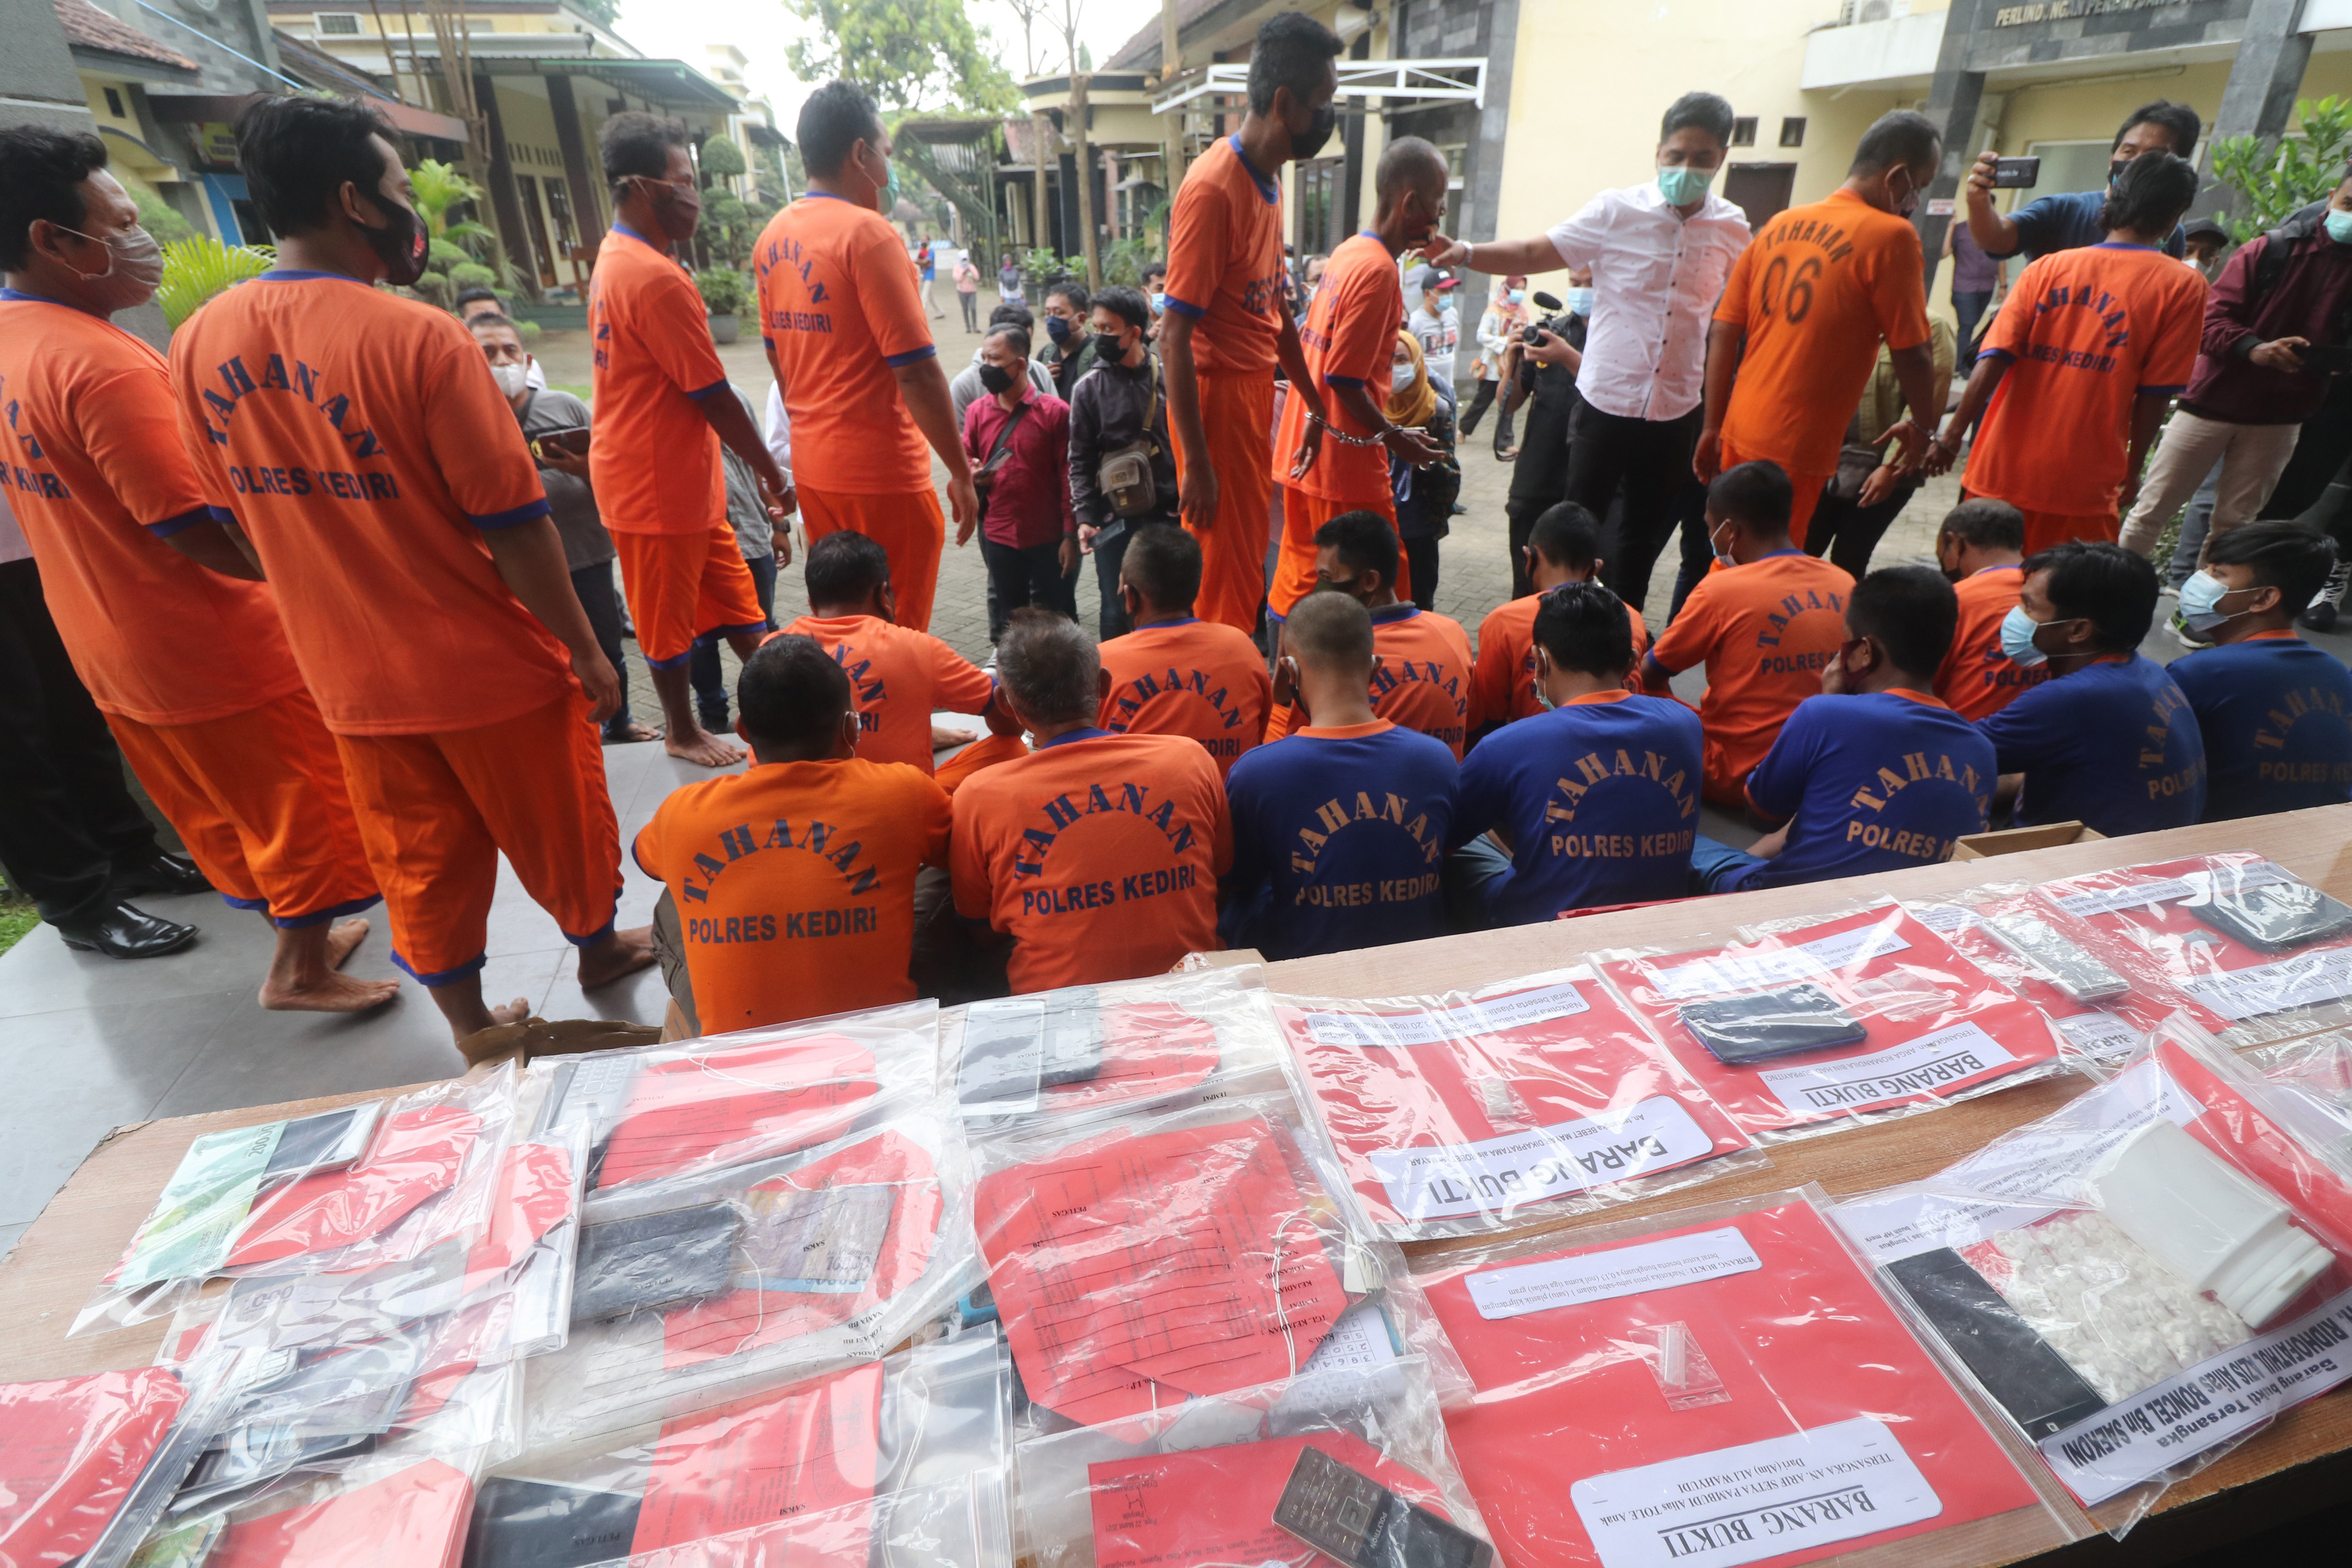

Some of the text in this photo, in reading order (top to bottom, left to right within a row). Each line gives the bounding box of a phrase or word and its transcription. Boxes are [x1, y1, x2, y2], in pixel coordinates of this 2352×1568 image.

[1766, 220, 1853, 263] TAHANAN
[1762, 255, 1822, 325] 06
[2062, 350, 2116, 373] KEDIRI
[1757, 590, 1843, 650] TAHAN
[1760, 653, 1825, 676] POLRES
[1108, 668, 1243, 733] TAHANAN
[1199, 738, 1240, 757] DIRI
[1545, 750, 1696, 825] TAHANAN
[1014, 783, 1195, 882] TAHANAN
[1292, 791, 1439, 874] TAHANAN
[1847, 820, 1935, 860] POLRES
[1552, 830, 1693, 858] POLRES KEDIRI
[684, 818, 881, 904] TAHANAN
[1023, 864, 1195, 916] POLRES KEDIRI
[1296, 872, 1440, 908] POLRES KEDIRI
[690, 907, 877, 944] POLRES KEDIRI
[1515, 996, 1549, 1010] beserta
[1550, 991, 1573, 1002] berat
[1516, 1008, 1538, 1021] jenis
[1539, 1001, 1582, 1017] Narkotika
[1388, 1021, 1408, 1031] (tiga
[1410, 1019, 1431, 1029] 3,20
[1401, 1031, 1429, 1040] (satu)
[1016, 1049, 1046, 1058] PETUGAS
[1895, 1046, 1916, 1059] ARGA
[1848, 1053, 1893, 1069] ROMANDILA
[1805, 1051, 1985, 1109] BARANG BUKTI
[1201, 1091, 1227, 1102] TEMPAT
[1631, 1113, 1644, 1122] An.
[1572, 1126, 1598, 1138] BEBET
[248, 1124, 276, 1158] 20000
[1488, 1138, 1545, 1156] DIKAPRATAMA
[1476, 1150, 1488, 1159] als
[1426, 1167, 1529, 1206] BUKTI
[1976, 1179, 2002, 1195] hitam
[1051, 1205, 1087, 1217] PETUGAS
[1978, 1206, 1999, 1221] butir
[1863, 1232, 1883, 1243] merk
[1881, 1230, 1894, 1239] HP
[1892, 1225, 1912, 1235] buah
[803, 1239, 826, 1253] SAKSI
[1877, 1235, 1908, 1251] bungkus
[1688, 1262, 1718, 1273] BUKTI
[1718, 1255, 1753, 1268] BARANG
[1507, 1252, 1719, 1295] berat kotor beserta bungkusnya 0,13 (nol koma tiga belas) gram
[1632, 1273, 1651, 1286] jenis
[1650, 1268, 1685, 1282] Narkotika
[632, 1276, 674, 1291] PETUGAS
[1273, 1279, 1312, 1295] KEJADIAN
[1576, 1285, 1598, 1295] dalam
[1598, 1279, 1632, 1292] sabu-sabu
[1288, 1296, 1319, 1309] TEMPAT
[1508, 1296, 1524, 1308] klip
[1524, 1292, 1548, 1305] plastik
[1548, 1288, 1569, 1301] (satu)
[1481, 1299, 1508, 1311] dengan
[847, 1309, 883, 1329] NAMA BB
[1267, 1318, 1308, 1335] KEJADIAN
[855, 1325, 883, 1343] LOKASI
[1308, 1332, 1334, 1345] KASUS
[1142, 1377, 1155, 1385] No.
[2198, 1362, 2237, 1400] Alias
[2244, 1380, 2280, 1408] bukti
[2141, 1377, 2209, 1431] BONCEL
[2118, 1406, 2150, 1442] Bin
[2151, 1395, 2249, 1452] Tersangka
[2057, 1416, 2128, 1472] SAEKONI
[1676, 1456, 1805, 1493] Dari (Alm) ALI WAHYUDI
[1599, 1451, 1893, 1527] TERSANGKA AN. ARIF SETYA PAMBUDI Alias TOLE Anak
[777, 1502, 806, 1516] SAKSI
[1369, 1511, 1388, 1549] POLYTRON
[1659, 1487, 1877, 1560] BARANG BUKTI
[572, 1531, 620, 1547] PETUGAS
